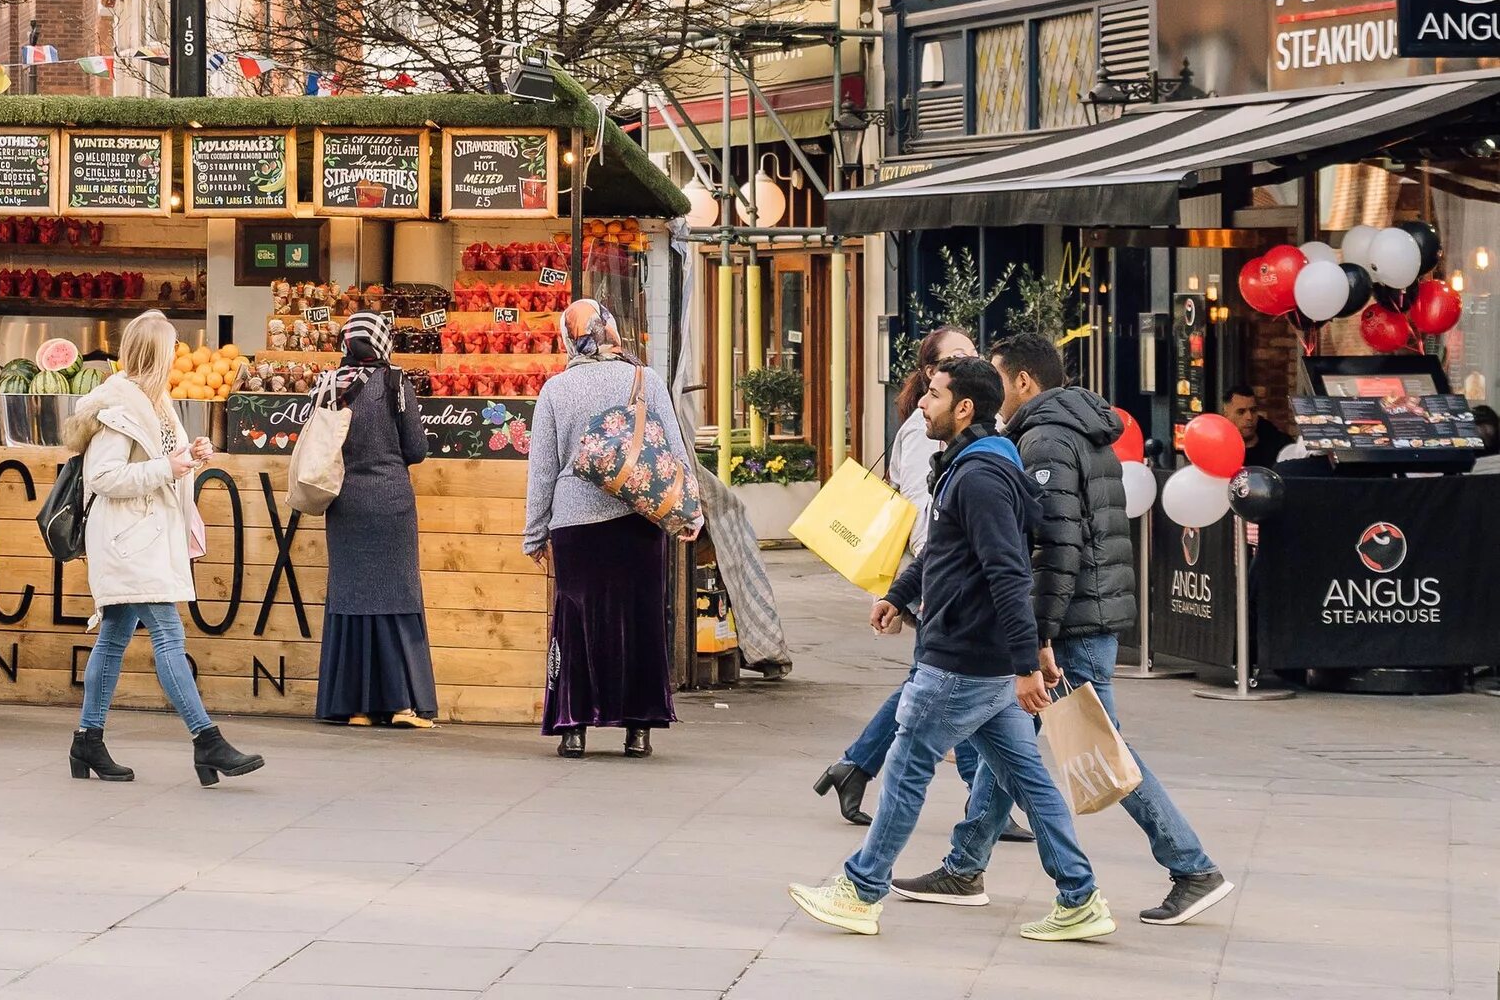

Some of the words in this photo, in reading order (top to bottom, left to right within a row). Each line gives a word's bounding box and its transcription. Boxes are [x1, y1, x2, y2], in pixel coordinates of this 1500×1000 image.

[184, 15, 194, 57] 159
[1276, 18, 1398, 71] STEAKHOU
[74, 138, 116, 149] WINTER
[116, 138, 159, 149] SPECIALS
[352, 136, 392, 144] CHILLED
[198, 140, 274, 152] MYLKSHAKES
[325, 144, 363, 155] BELGIAN
[369, 145, 418, 157] CHOCOLATE
[455, 140, 518, 158] STRAWBERRIES
[18, 149, 46, 157] SUNRISE
[85, 152, 136, 163] MELONBERRY
[263, 151, 279, 160] MILK)
[209, 163, 257, 171] STRAWBERRY
[349, 155, 396, 168] dipped
[3, 173, 36, 181] BOOSTER
[85, 167, 120, 177] ENGLISH
[125, 169, 147, 178] ROSE
[209, 174, 237, 182] BANANA
[324, 168, 417, 191] STRAWBERRIES
[463, 173, 504, 184] MELTED
[14, 188, 32, 196] BOTTLE
[75, 184, 92, 193] SMALL
[100, 185, 118, 193] LARGE
[127, 186, 147, 194] BOTTLE
[328, 186, 351, 199] PLEASE
[455, 184, 482, 196] BELGIAN
[483, 185, 517, 196] CHOCOLATE
[4, 196, 21, 205] Only
[98, 195, 117, 204] Cash
[117, 195, 136, 207] Only
[195, 196, 214, 204] SMALL
[226, 196, 242, 205] LARGE
[243, 196, 252, 205] £5
[392, 193, 412, 206] £10
[475, 196, 491, 207] £5
[271, 232, 283, 240] NOW
[257, 251, 275, 260] eats
[418, 404, 477, 426] ocolate
[829, 519, 861, 548] SELFRIDGES
[1171, 569, 1211, 602] ANGUS
[1322, 577, 1441, 607] ANGUS
[1171, 599, 1212, 619] STEAKHOUSE
[1321, 608, 1441, 624] STEAKHOUSE
